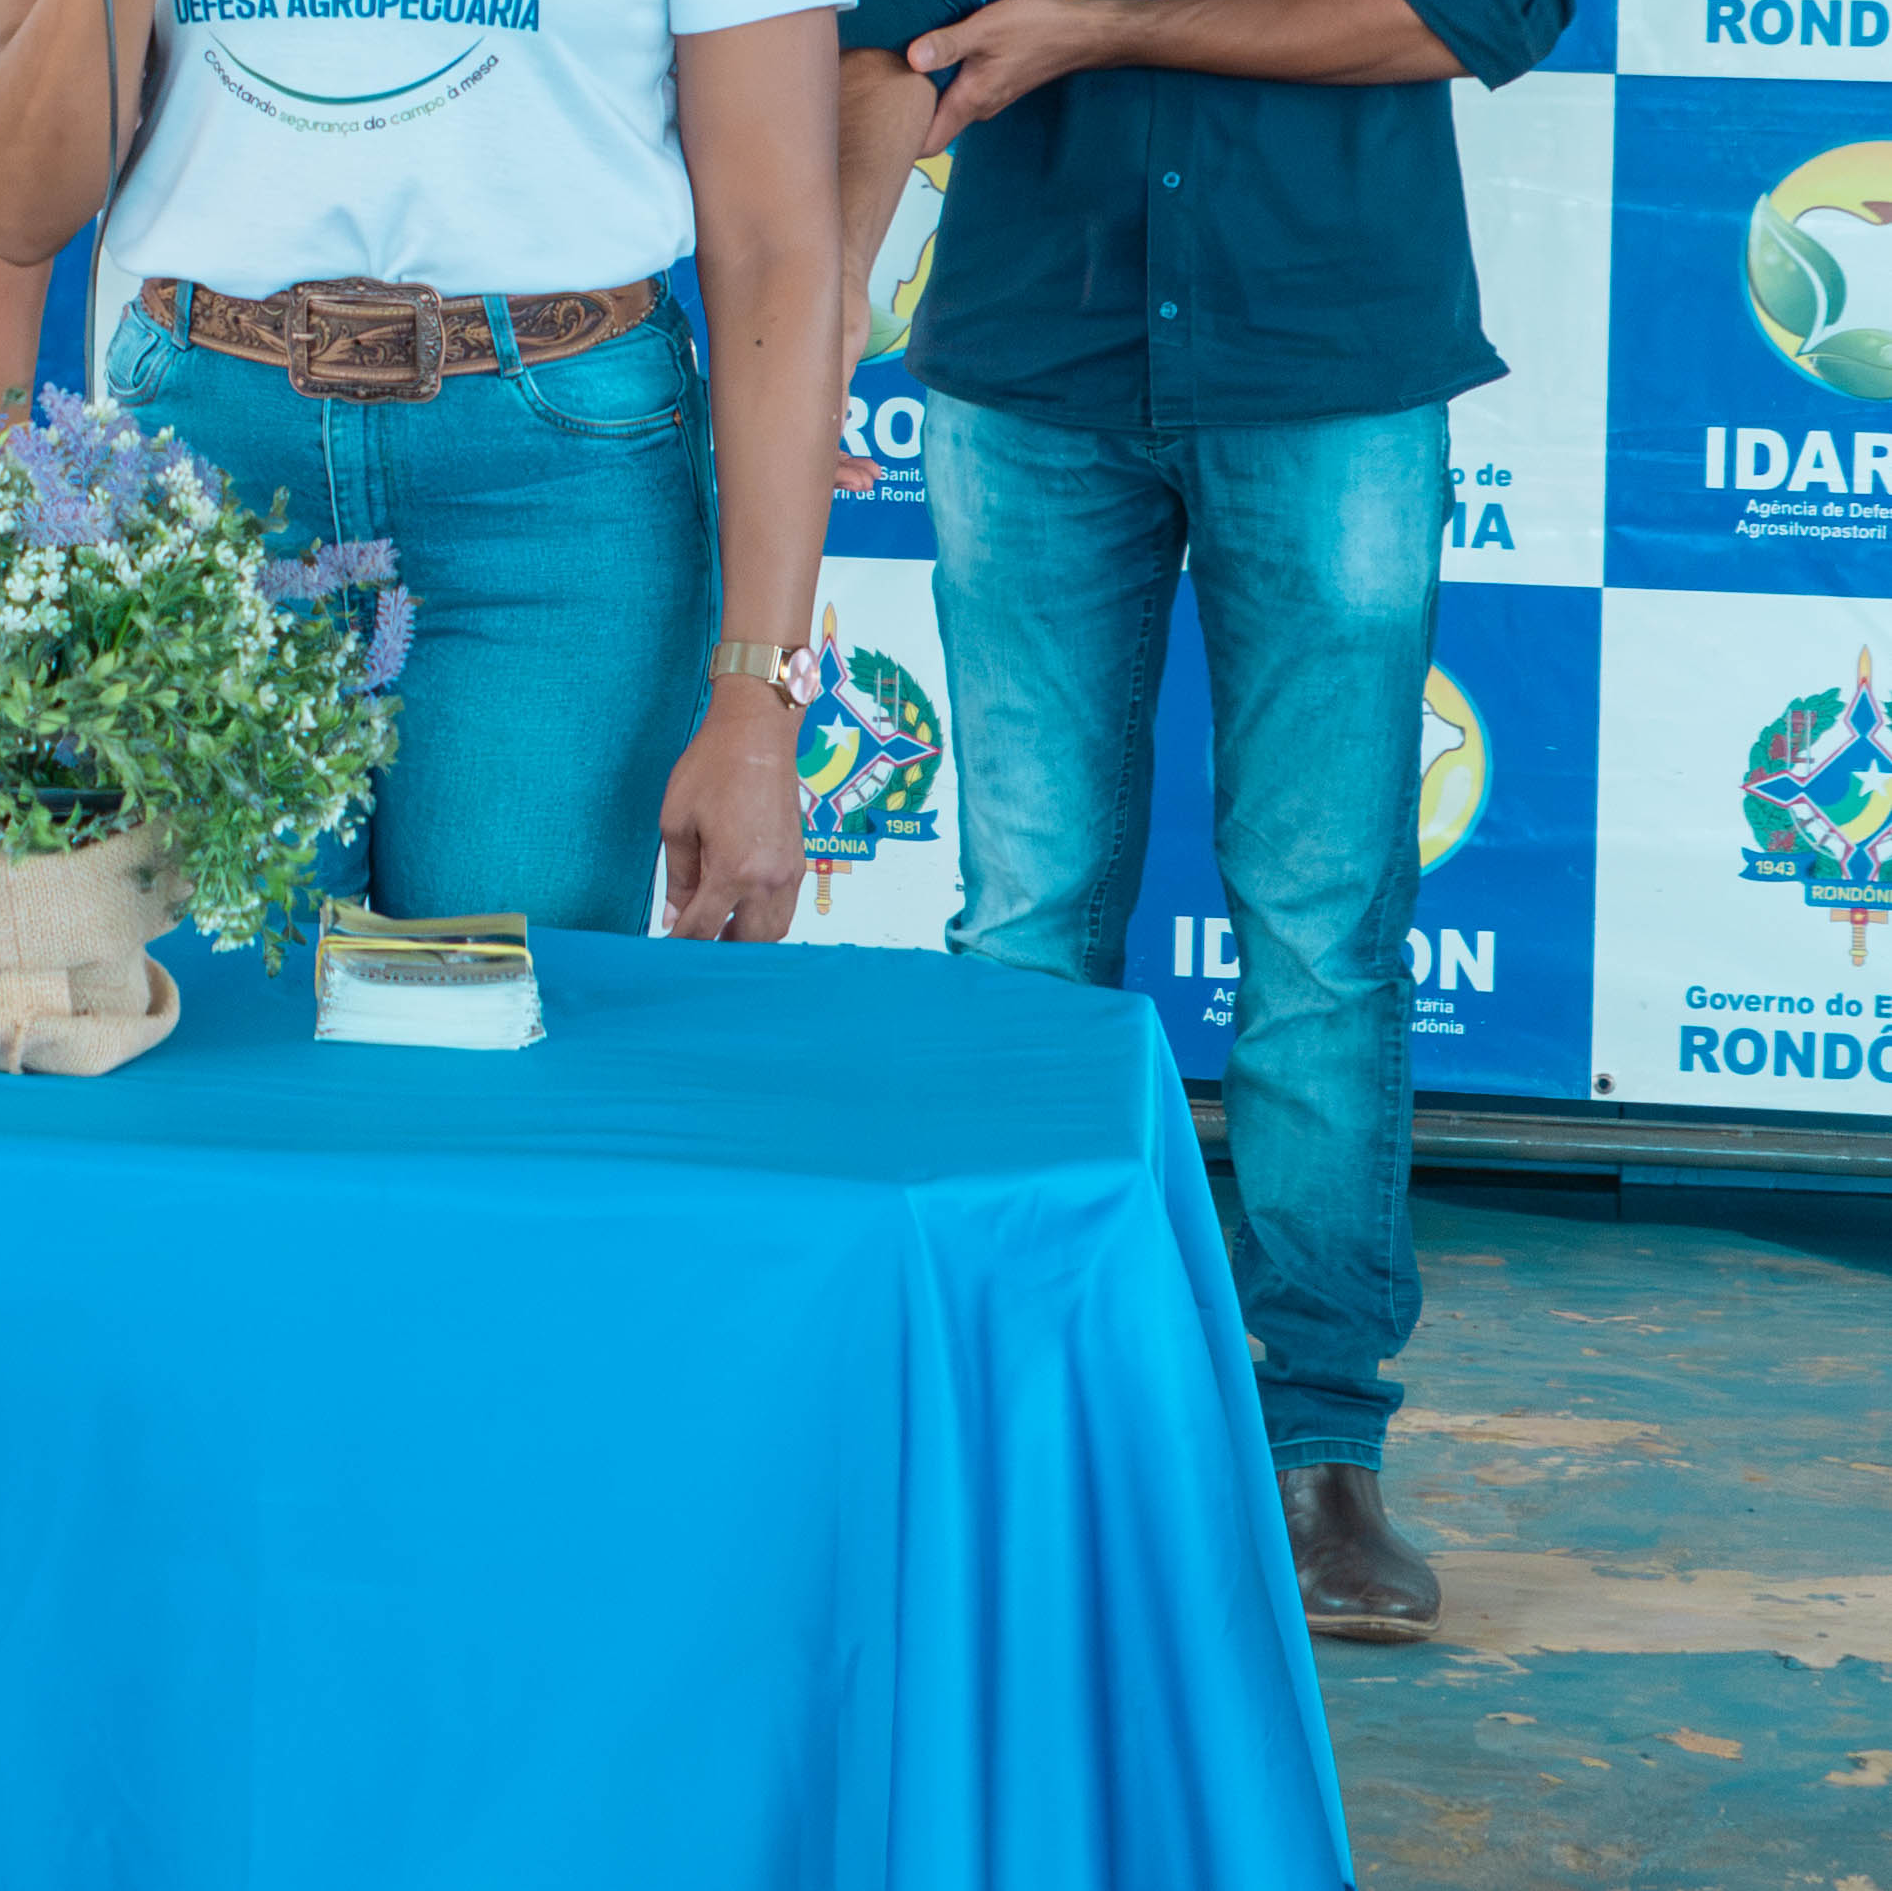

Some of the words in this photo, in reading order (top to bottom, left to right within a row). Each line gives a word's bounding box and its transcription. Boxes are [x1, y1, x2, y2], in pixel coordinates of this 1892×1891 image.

[204, 49, 278, 118] Conectando
[278, 110, 361, 138] segurança
[363, 114, 387, 132] do
[390, 94, 447, 128] campo
[460, 53, 500, 93] mesa
[1705, 426, 1892, 495] IDAR
[1475, 463, 1513, 487] de
[881, 486, 926, 503] Rond
[1746, 498, 1817, 520] Agência
[1822, 502, 1845, 518] de
[1735, 519, 1887, 541] Agrosilvopastoril
[886, 819, 921, 835] 1981
[803, 835, 870, 854] NDÔNIA
[1755, 860, 1796, 876] 1943
[1685, 985, 1814, 1014] Governo
[1825, 988, 1862, 1016] do
